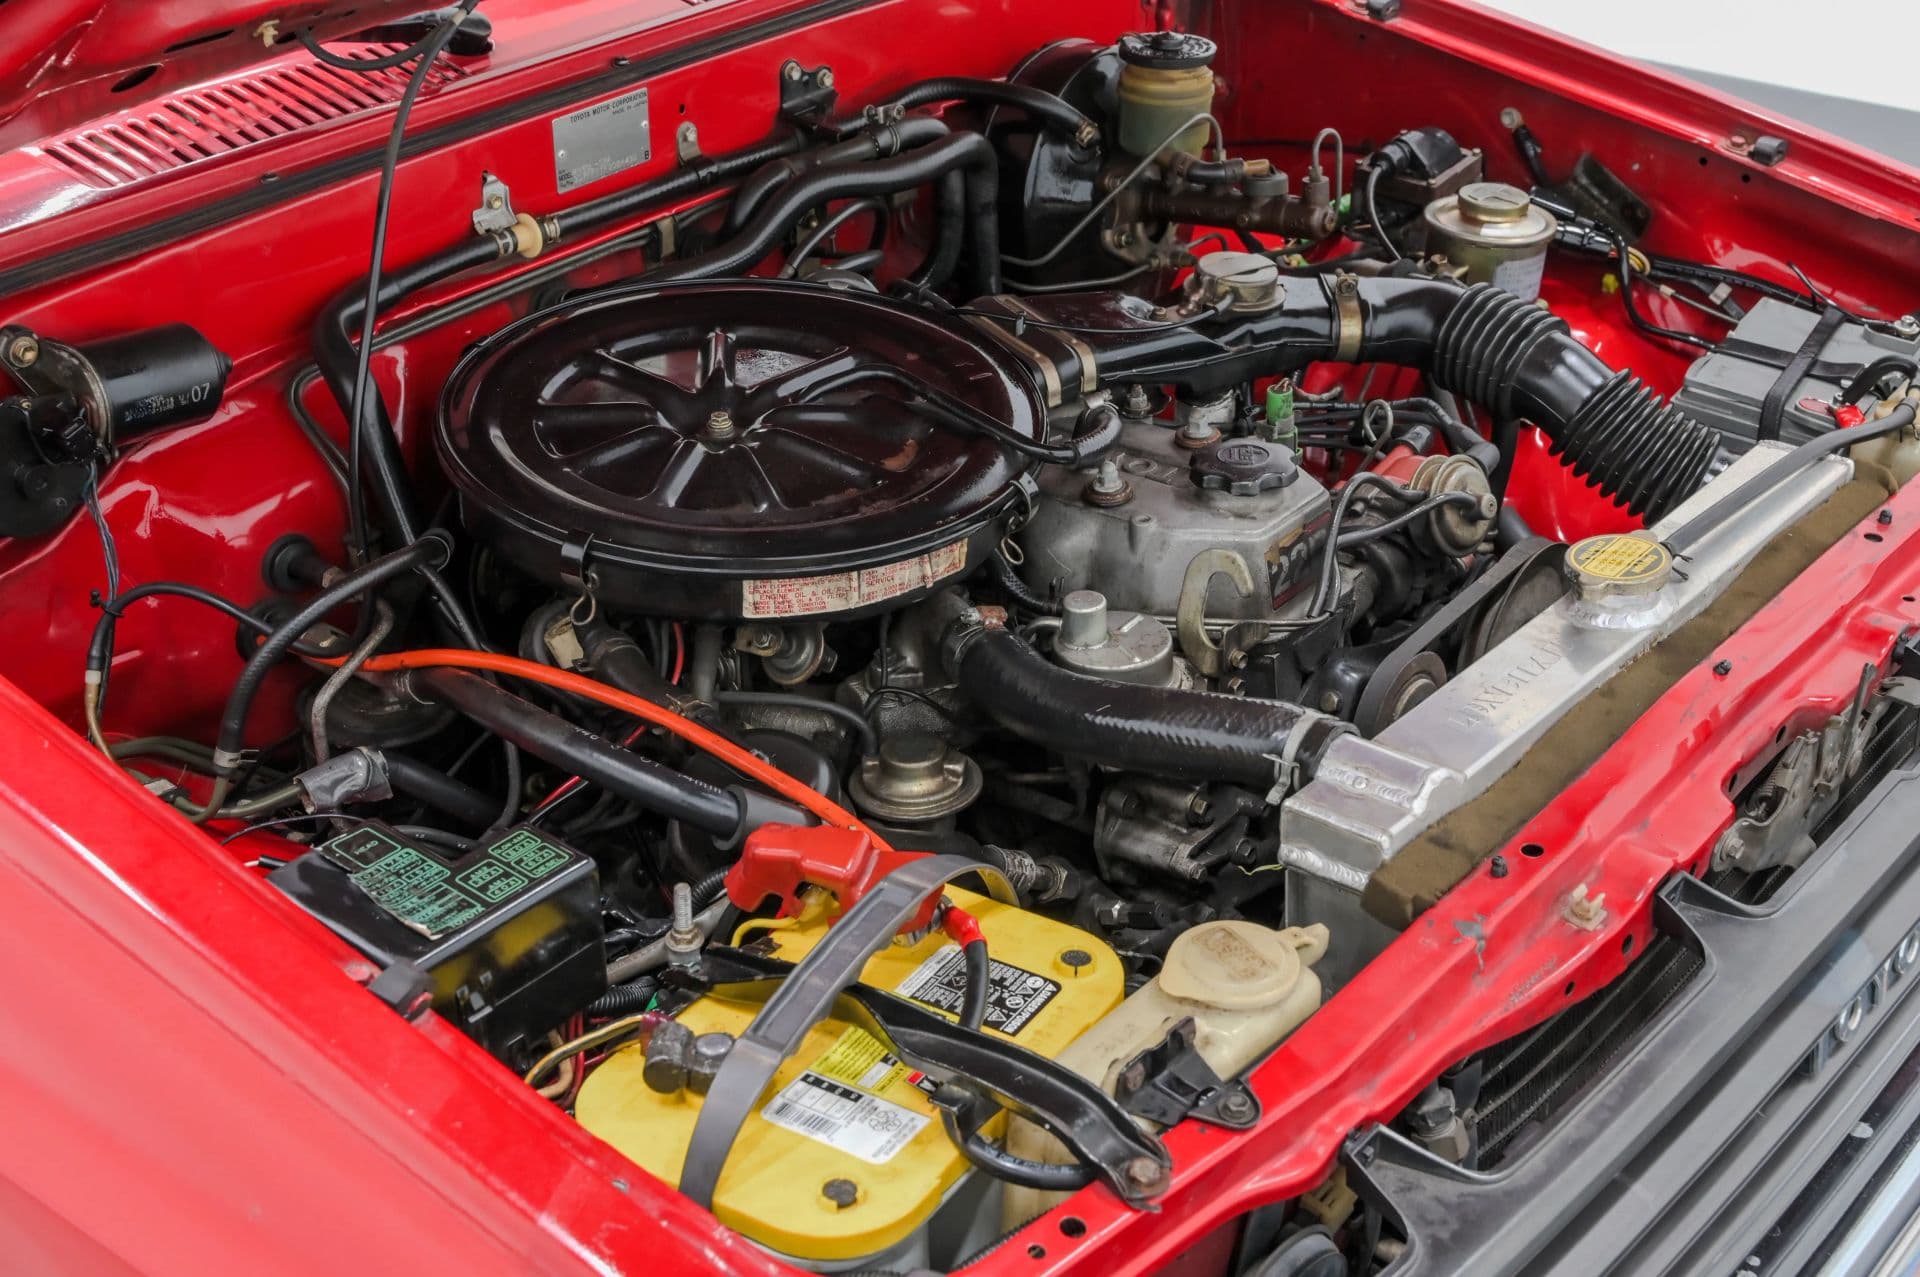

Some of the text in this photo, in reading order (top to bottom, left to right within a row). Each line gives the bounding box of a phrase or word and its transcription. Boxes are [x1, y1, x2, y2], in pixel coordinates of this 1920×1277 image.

[570, 91, 648, 123] TOYOTA MOTOR CORPORATION
[644, 150, 650, 160] B
[191, 382, 210, 403] 07
[354, 841, 379, 855] HEAD
[451, 906, 486, 928] TOYOTA
[1003, 988, 1052, 1034] DANGER/POISON
